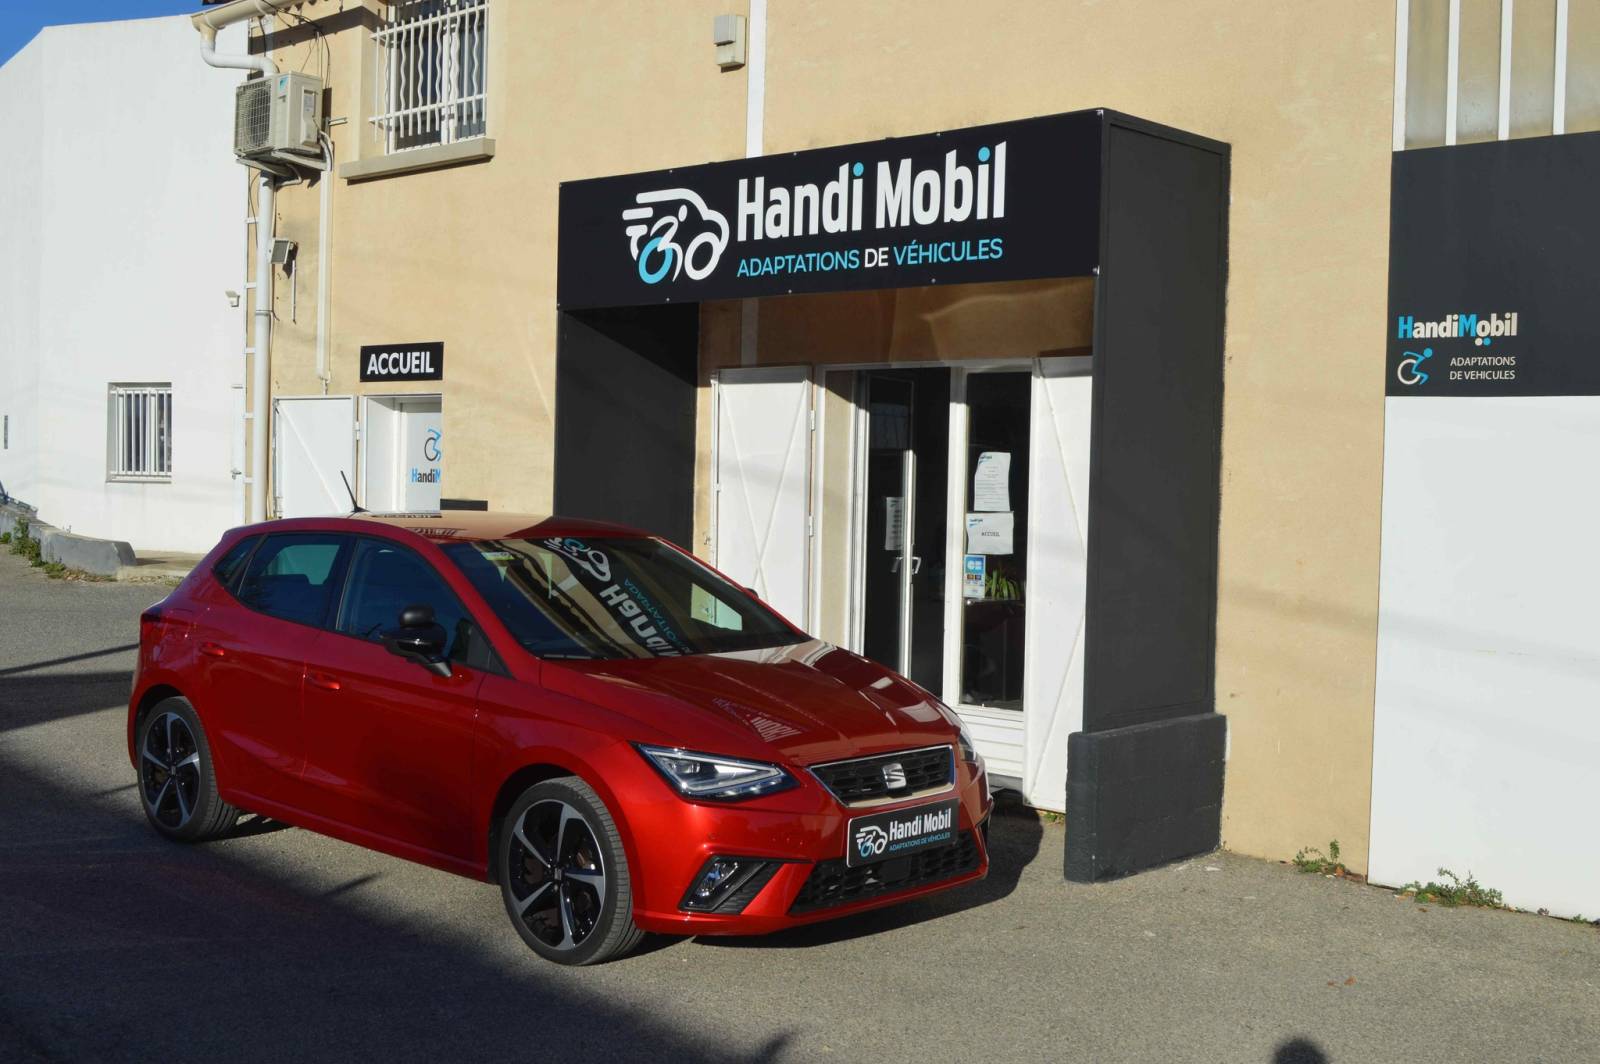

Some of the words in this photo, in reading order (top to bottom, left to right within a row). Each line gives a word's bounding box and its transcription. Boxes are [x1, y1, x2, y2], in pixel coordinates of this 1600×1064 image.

[737, 162, 864, 242] Handi
[875, 141, 1007, 229] Mobil
[736, 249, 860, 277] ADAPTATIONS
[864, 247, 888, 268] DE
[894, 238, 1003, 266] VÉHICULES
[1397, 312, 1518, 339] HandiMobil
[366, 351, 435, 375] ACCUEIL
[1449, 370, 1463, 380] DE
[1464, 370, 1516, 380] VEHICULES
[1450, 356, 1516, 367] ADAPTATIONS
[889, 815, 922, 841] Handi
[923, 807, 951, 833] Mobil
